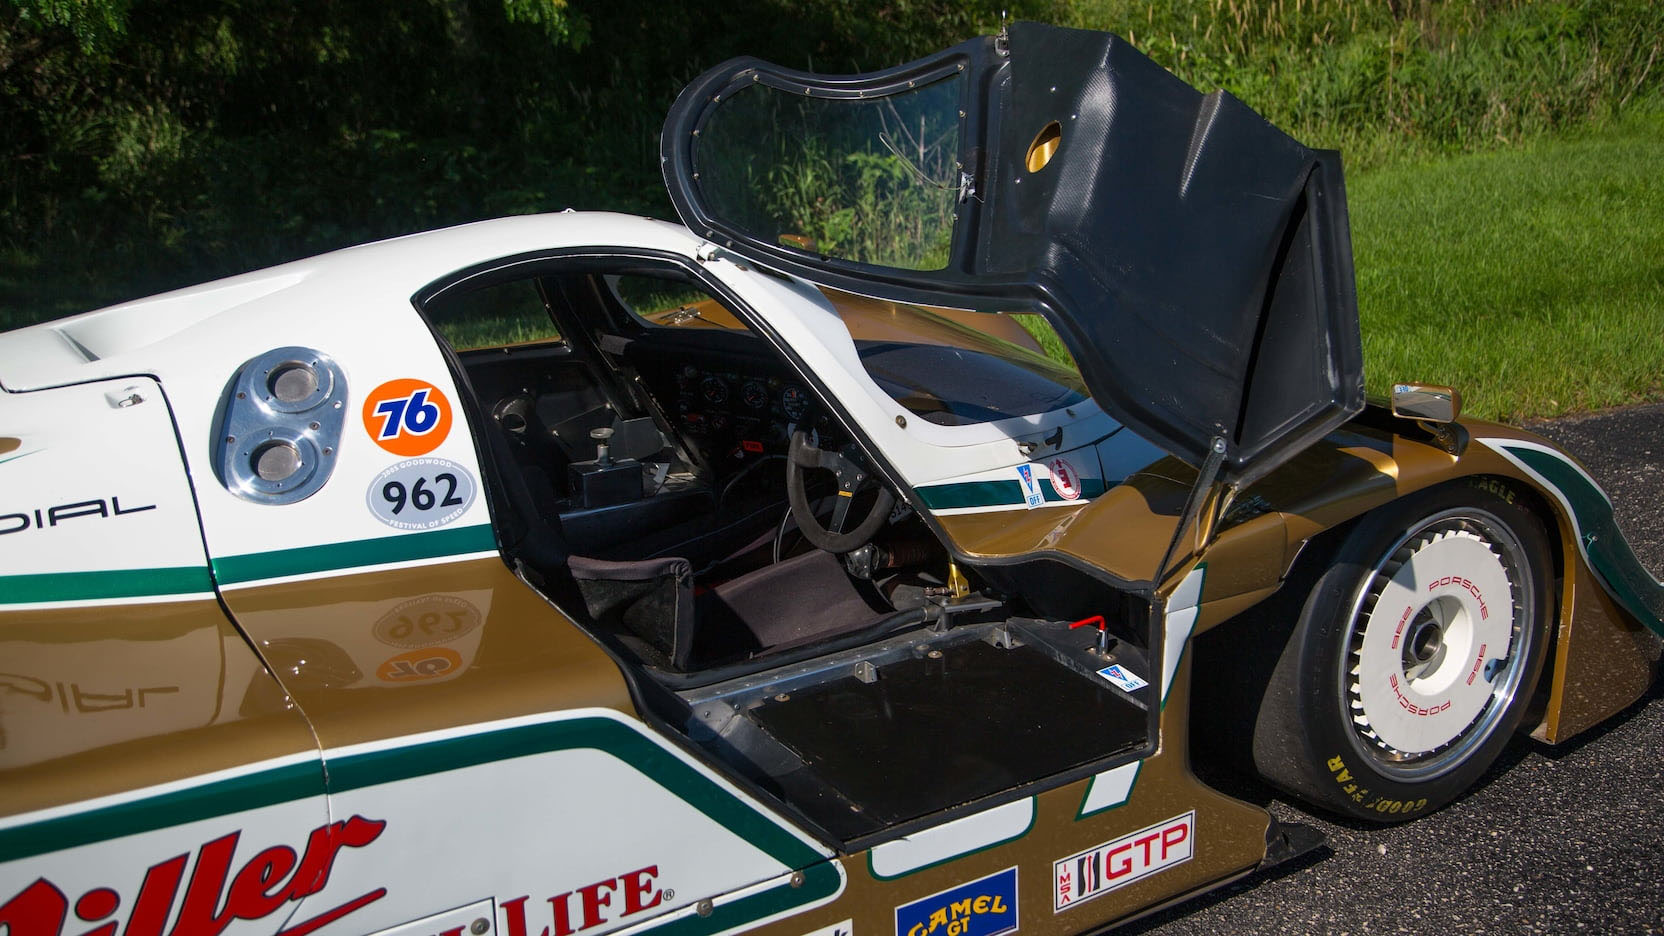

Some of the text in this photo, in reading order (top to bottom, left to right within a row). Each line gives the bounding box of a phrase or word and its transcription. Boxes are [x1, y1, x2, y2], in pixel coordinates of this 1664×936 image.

[372, 388, 441, 440] 76
[382, 458, 452, 478] 2005 GOODWOOD
[383, 473, 463, 515] 962
[1029, 495, 1041, 506] OFF
[389, 507, 463, 529] FESTIVAL OF SPEED
[1428, 576, 1489, 621] PORSCHE
[1389, 673, 1451, 717] PORSCHE
[1106, 823, 1188, 880] GTP
[1060, 863, 1071, 904] IMSA
[907, 895, 1007, 936] CAMEL
[947, 916, 970, 936] GT
